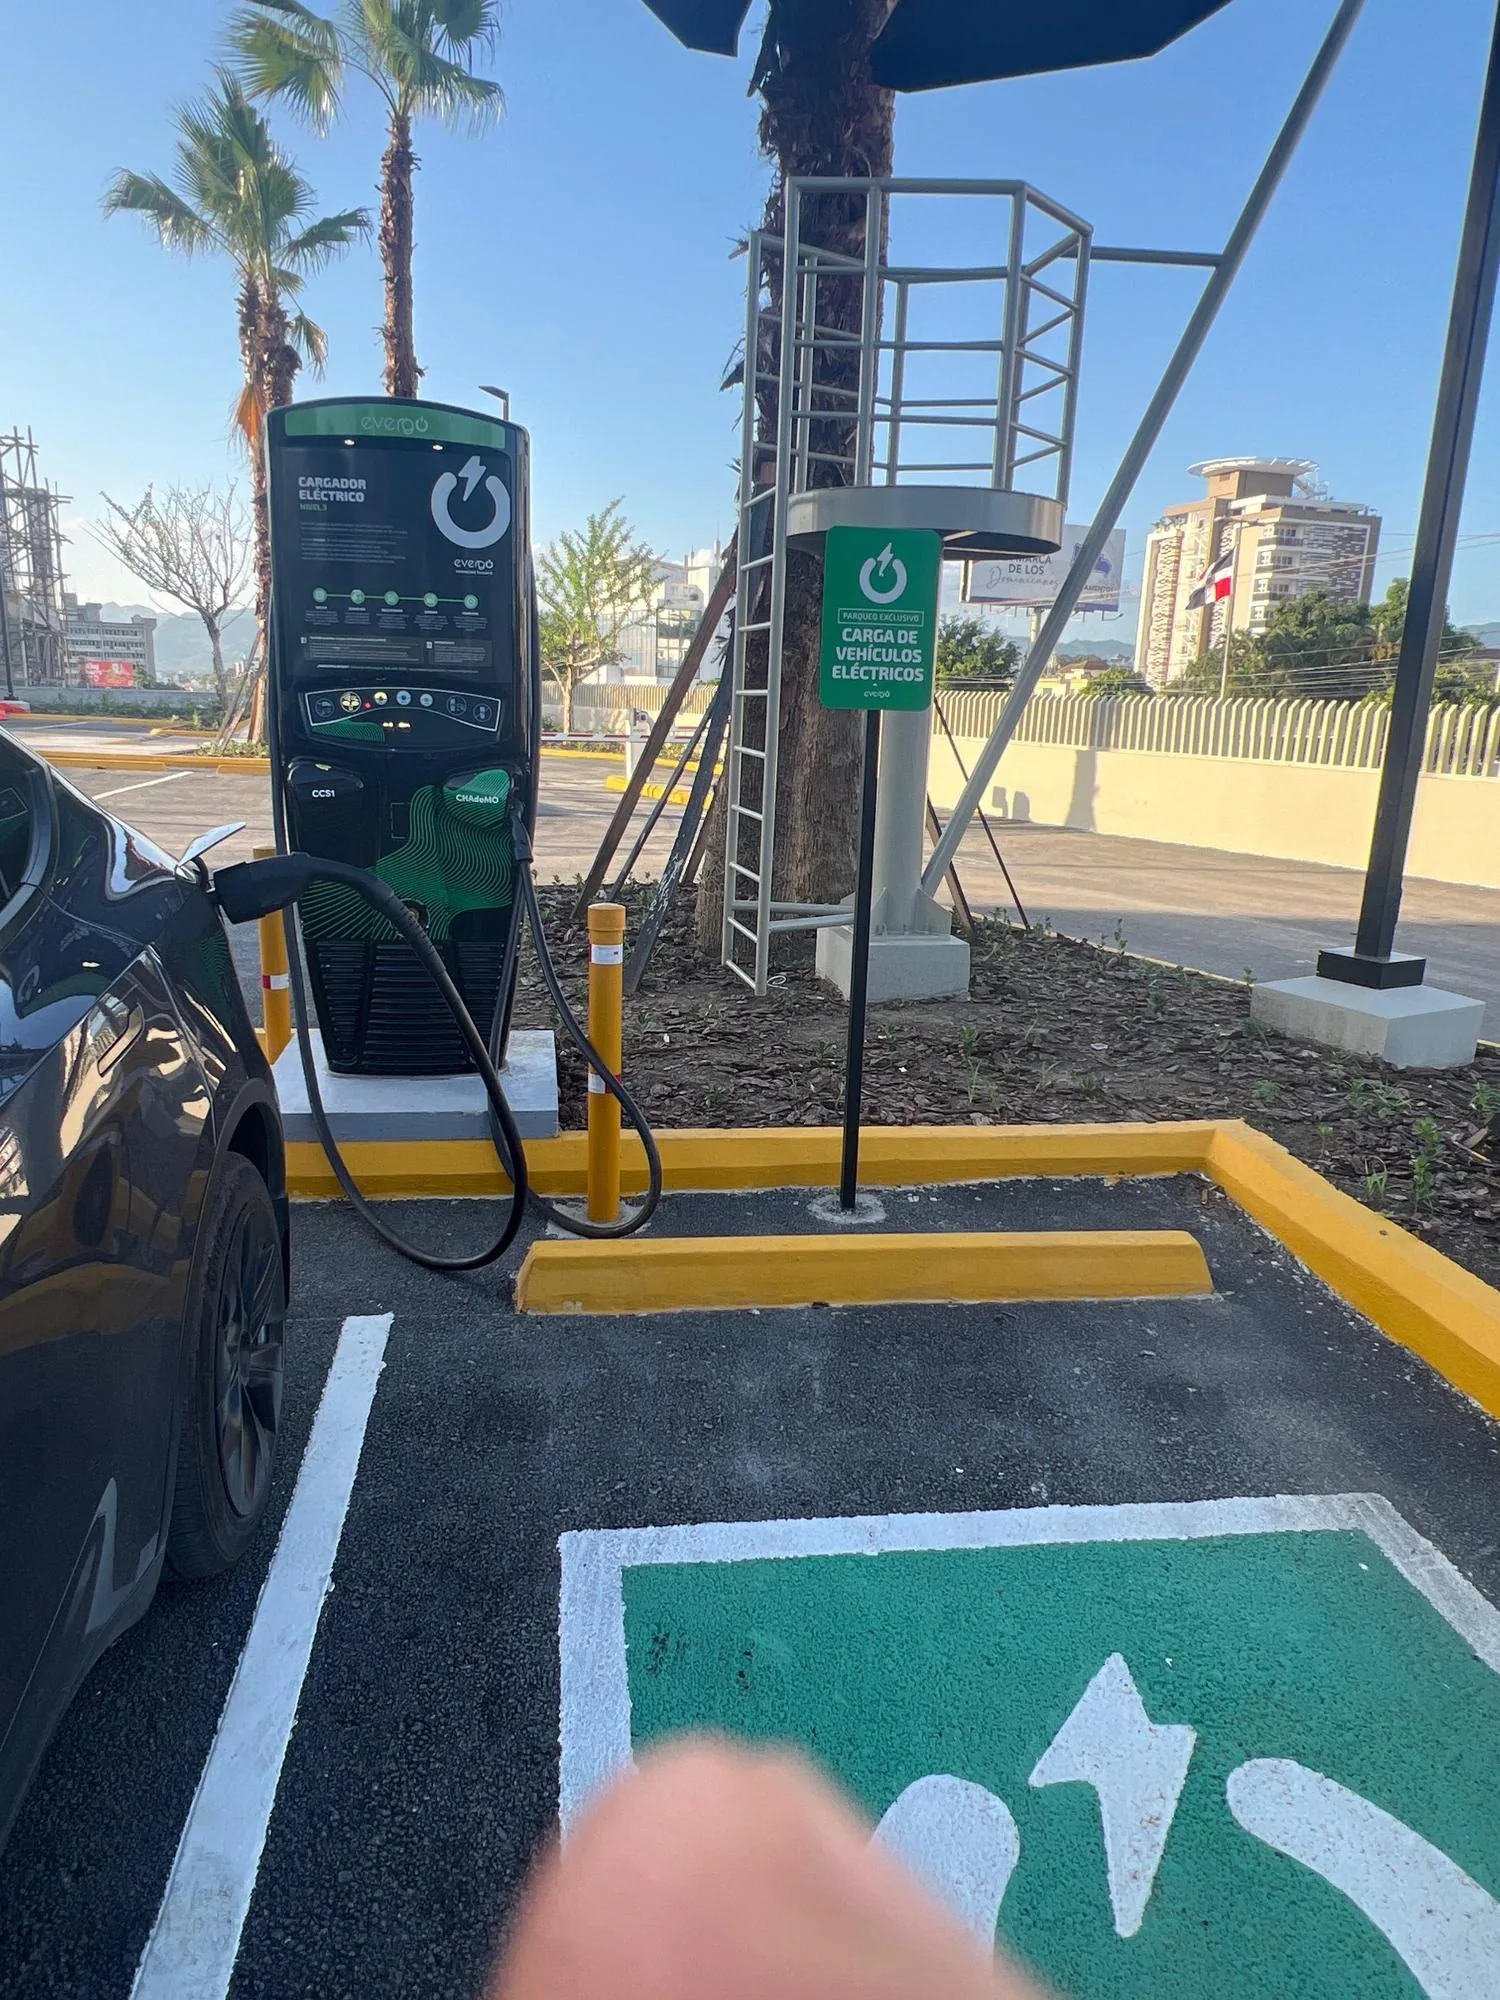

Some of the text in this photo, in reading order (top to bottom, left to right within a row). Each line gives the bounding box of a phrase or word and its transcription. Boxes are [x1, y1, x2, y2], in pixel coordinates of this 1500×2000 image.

[298, 477, 367, 490] CARGADOR
[299, 488, 365, 502] ELÉCTRICO
[454, 558, 494, 570] evergo
[1008, 564, 1044, 575] DE LOS
[843, 612, 919, 622] PARQUEO EXCLUSIVO
[842, 628, 918, 644] CARGA DE
[836, 644, 922, 663] VEHÍCULOS
[832, 662, 924, 682] ELÉCTRICOS
[312, 789, 335, 798] CCS1
[455, 794, 499, 804] CHAdeMO
